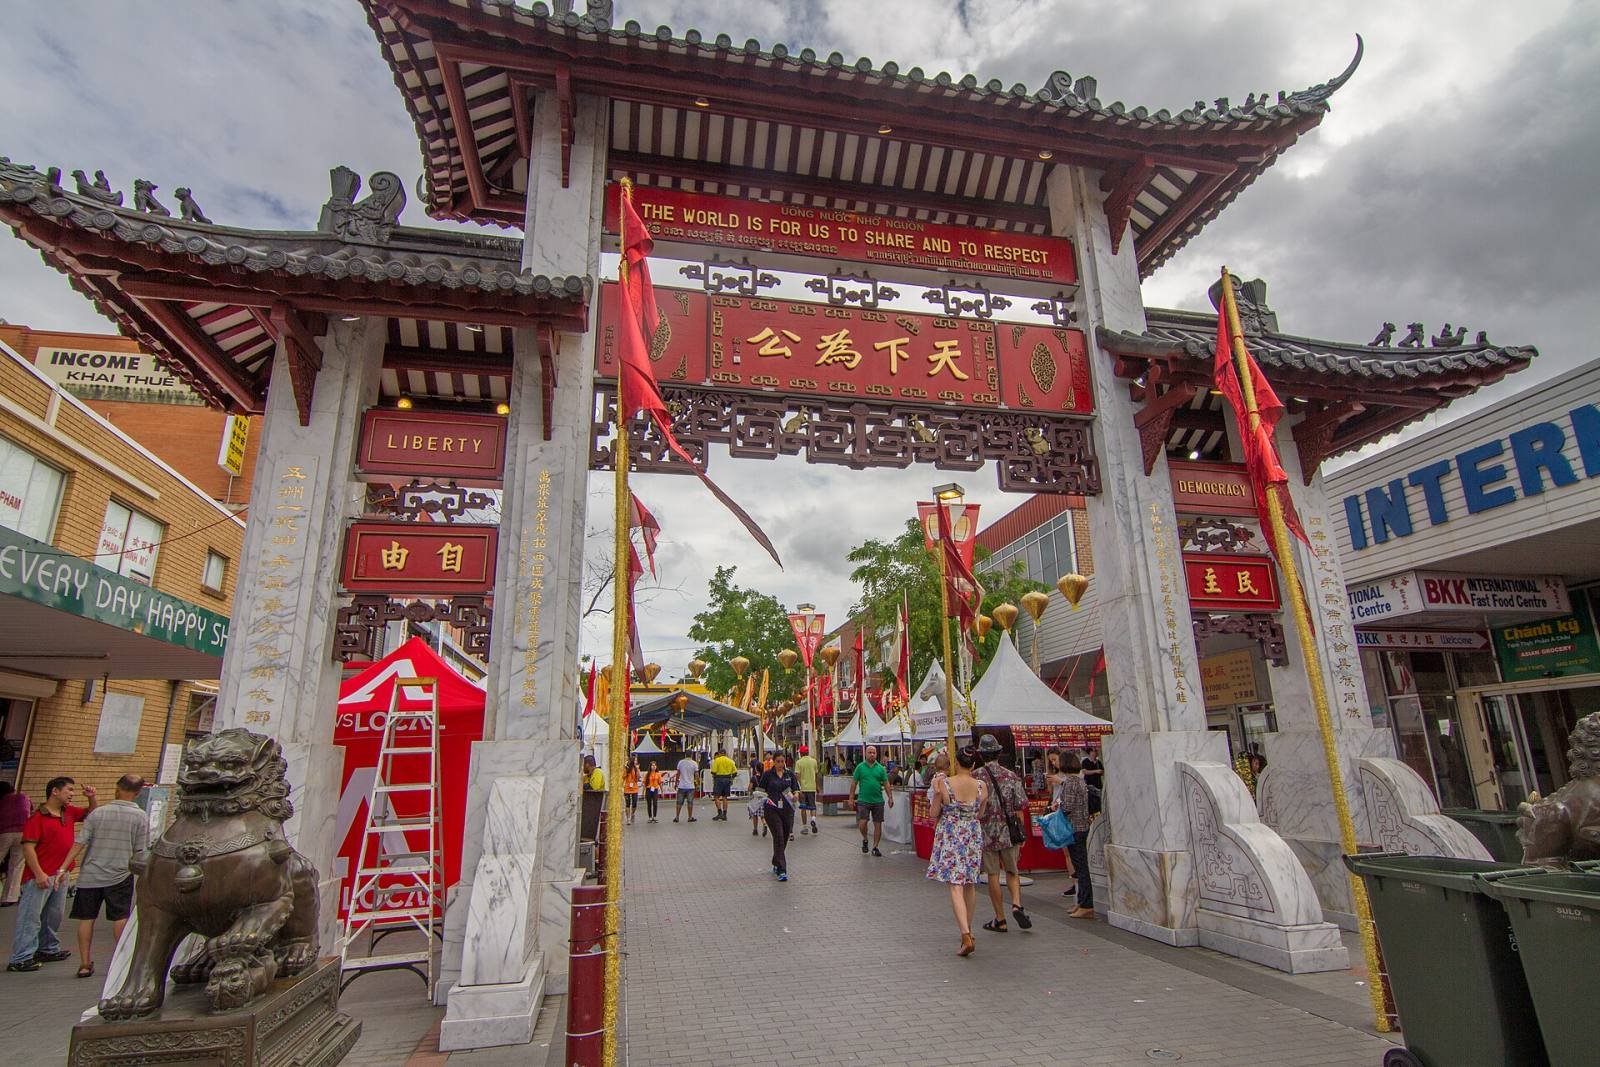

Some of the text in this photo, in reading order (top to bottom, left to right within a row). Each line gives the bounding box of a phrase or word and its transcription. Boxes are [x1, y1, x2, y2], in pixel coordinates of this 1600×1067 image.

[641, 203, 674, 221] THE
[683, 208, 739, 228] WORLD
[747, 215, 762, 231] IS
[770, 219, 800, 236] FOR
[809, 223, 829, 239] US
[838, 227, 858, 242] TO
[865, 231, 914, 249] SHARE
[922, 237, 950, 254] AND
[959, 241, 977, 256] TO
[984, 244, 1048, 265] RESPECT
[50, 351, 141, 371] INCOME
[66, 371, 115, 383] KHAI
[387, 434, 482, 453] LIBERTY
[1179, 480, 1246, 497] DEMOCRACY
[0, 545, 88, 600] EVERY
[96, 578, 142, 618] DAY
[147, 598, 207, 640] HAPPY
[1424, 579, 1471, 605] BKK
[1467, 578, 1541, 593] INTERNATIONAL
[1471, 593, 1491, 607] Fast
[1493, 594, 1515, 608] Food
[1517, 594, 1547, 608] Centre
[1357, 601, 1392, 618] Centre
[1356, 633, 1381, 645] BKK
[1542, 645, 1572, 654] GROCERY
[1556, 906, 1582, 916] SULO
